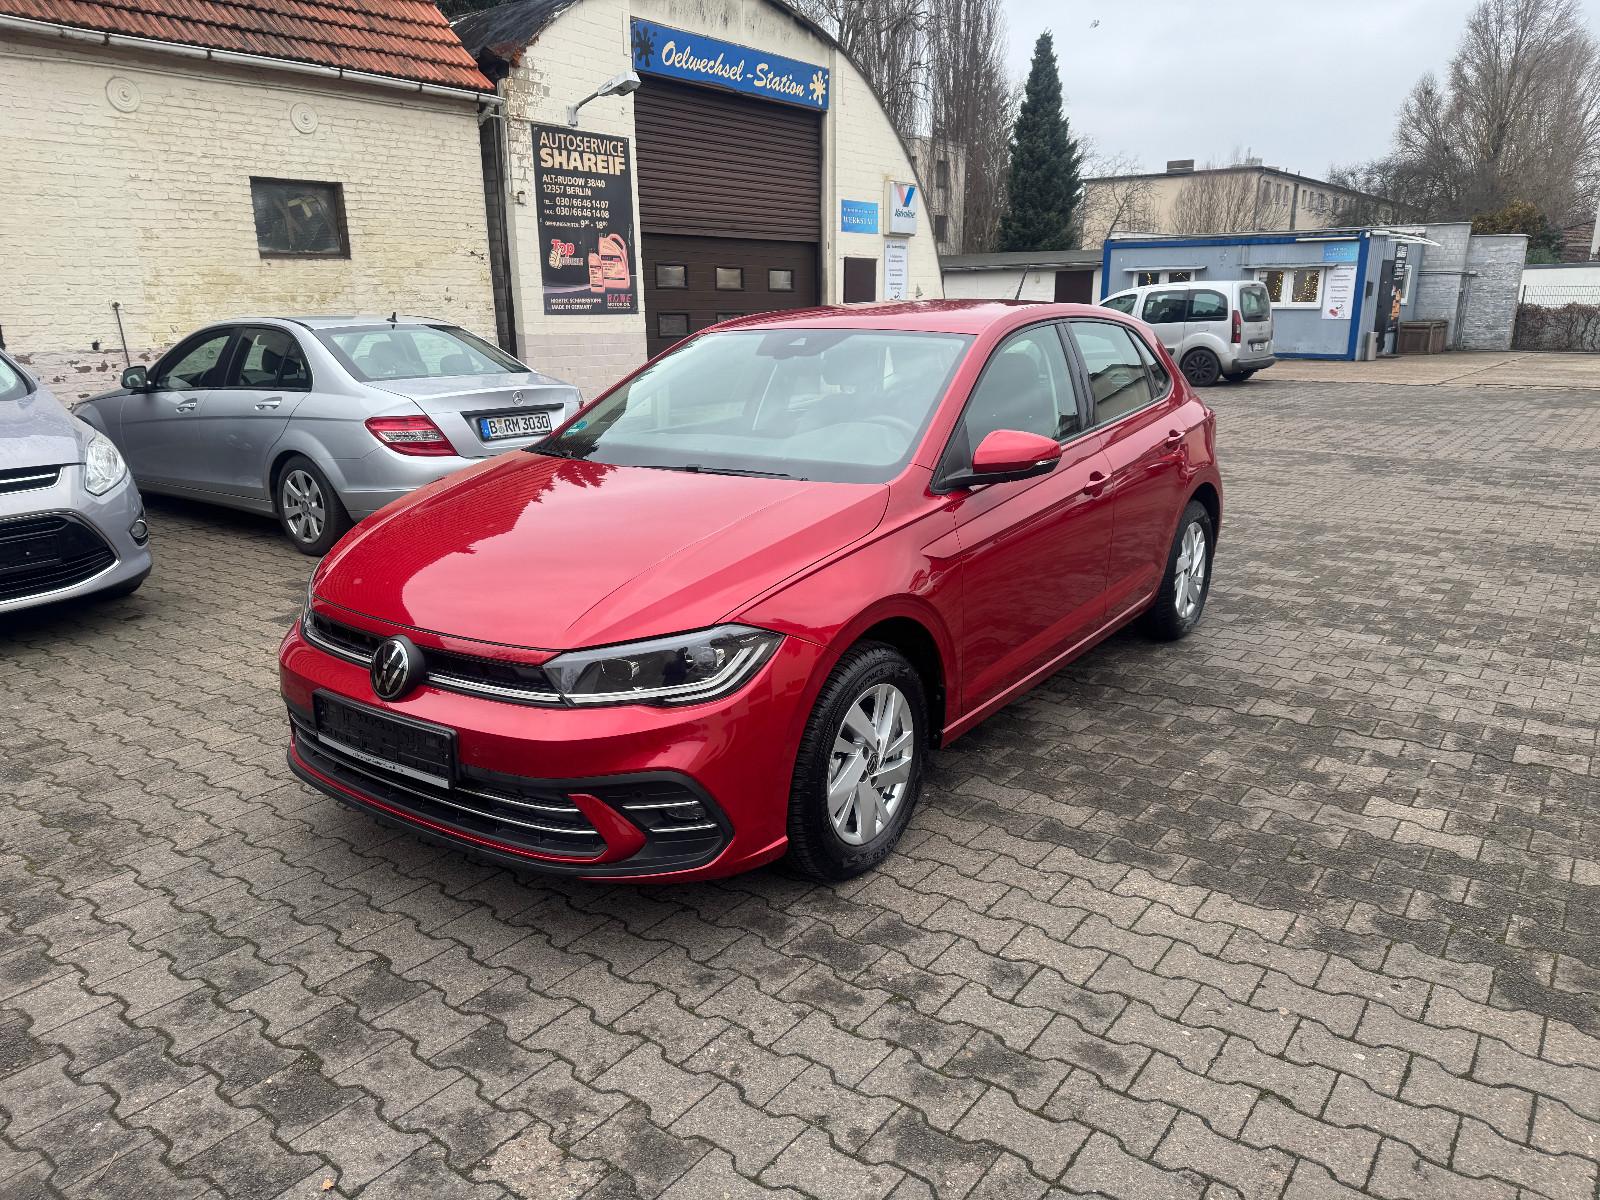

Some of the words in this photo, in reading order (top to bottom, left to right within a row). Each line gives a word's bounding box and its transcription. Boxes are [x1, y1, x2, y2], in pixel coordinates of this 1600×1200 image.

[540, 132, 624, 157] AUTOSERVICE
[540, 147, 626, 175] SHAREIF
[543, 174, 585, 186] ALT-RUDOW
[543, 184, 564, 194] 12357
[566, 186, 592, 196] BERLIN
[489, 420, 498, 434] B
[521, 416, 548, 430] 3030
